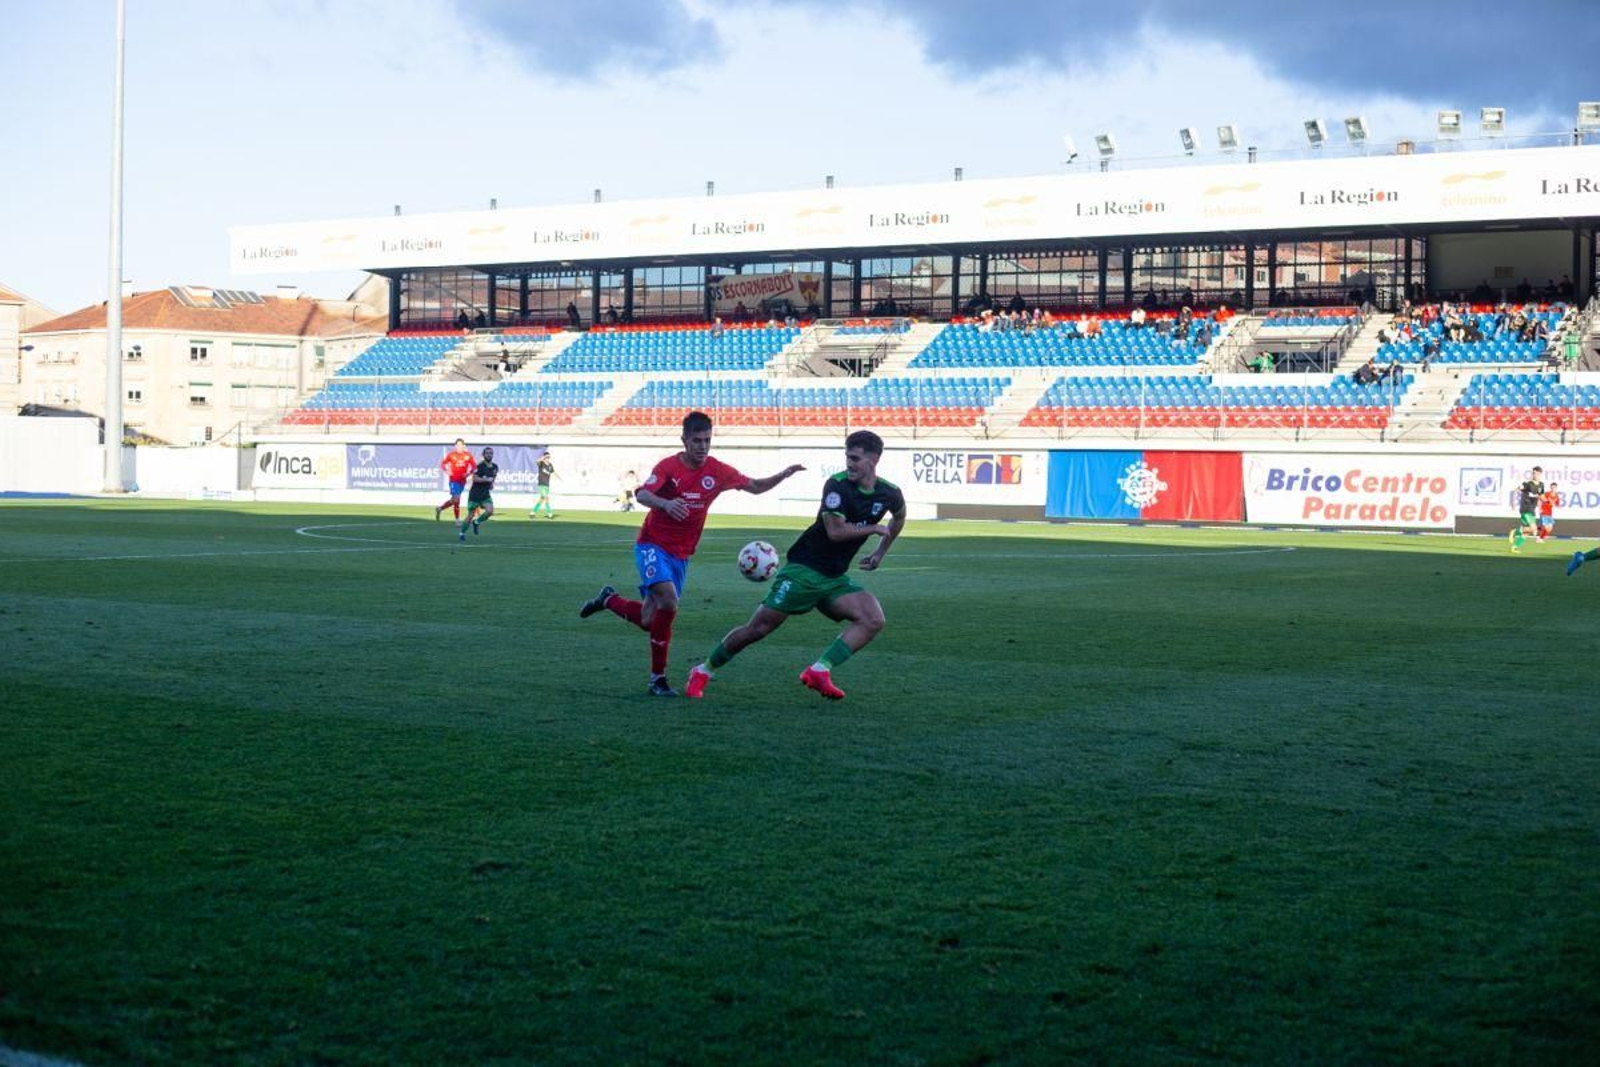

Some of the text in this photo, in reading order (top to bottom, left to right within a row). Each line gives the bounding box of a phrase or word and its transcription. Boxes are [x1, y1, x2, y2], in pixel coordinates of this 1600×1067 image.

[1541, 179, 1569, 195] La
[1299, 191, 1325, 206] La
[1076, 202, 1099, 217] La
[869, 213, 890, 228] La
[691, 223, 711, 235] La
[533, 231, 551, 244] La
[242, 247, 257, 260] La
[382, 239, 398, 253] La
[723, 274, 795, 300] ESCORNABOYS
[913, 452, 964, 468] PONTE
[913, 468, 962, 485] VELLA
[1265, 467, 1448, 494] BricoCentro
[1510, 464, 1600, 486] homigo
[1301, 496, 1448, 523] Paradelo
